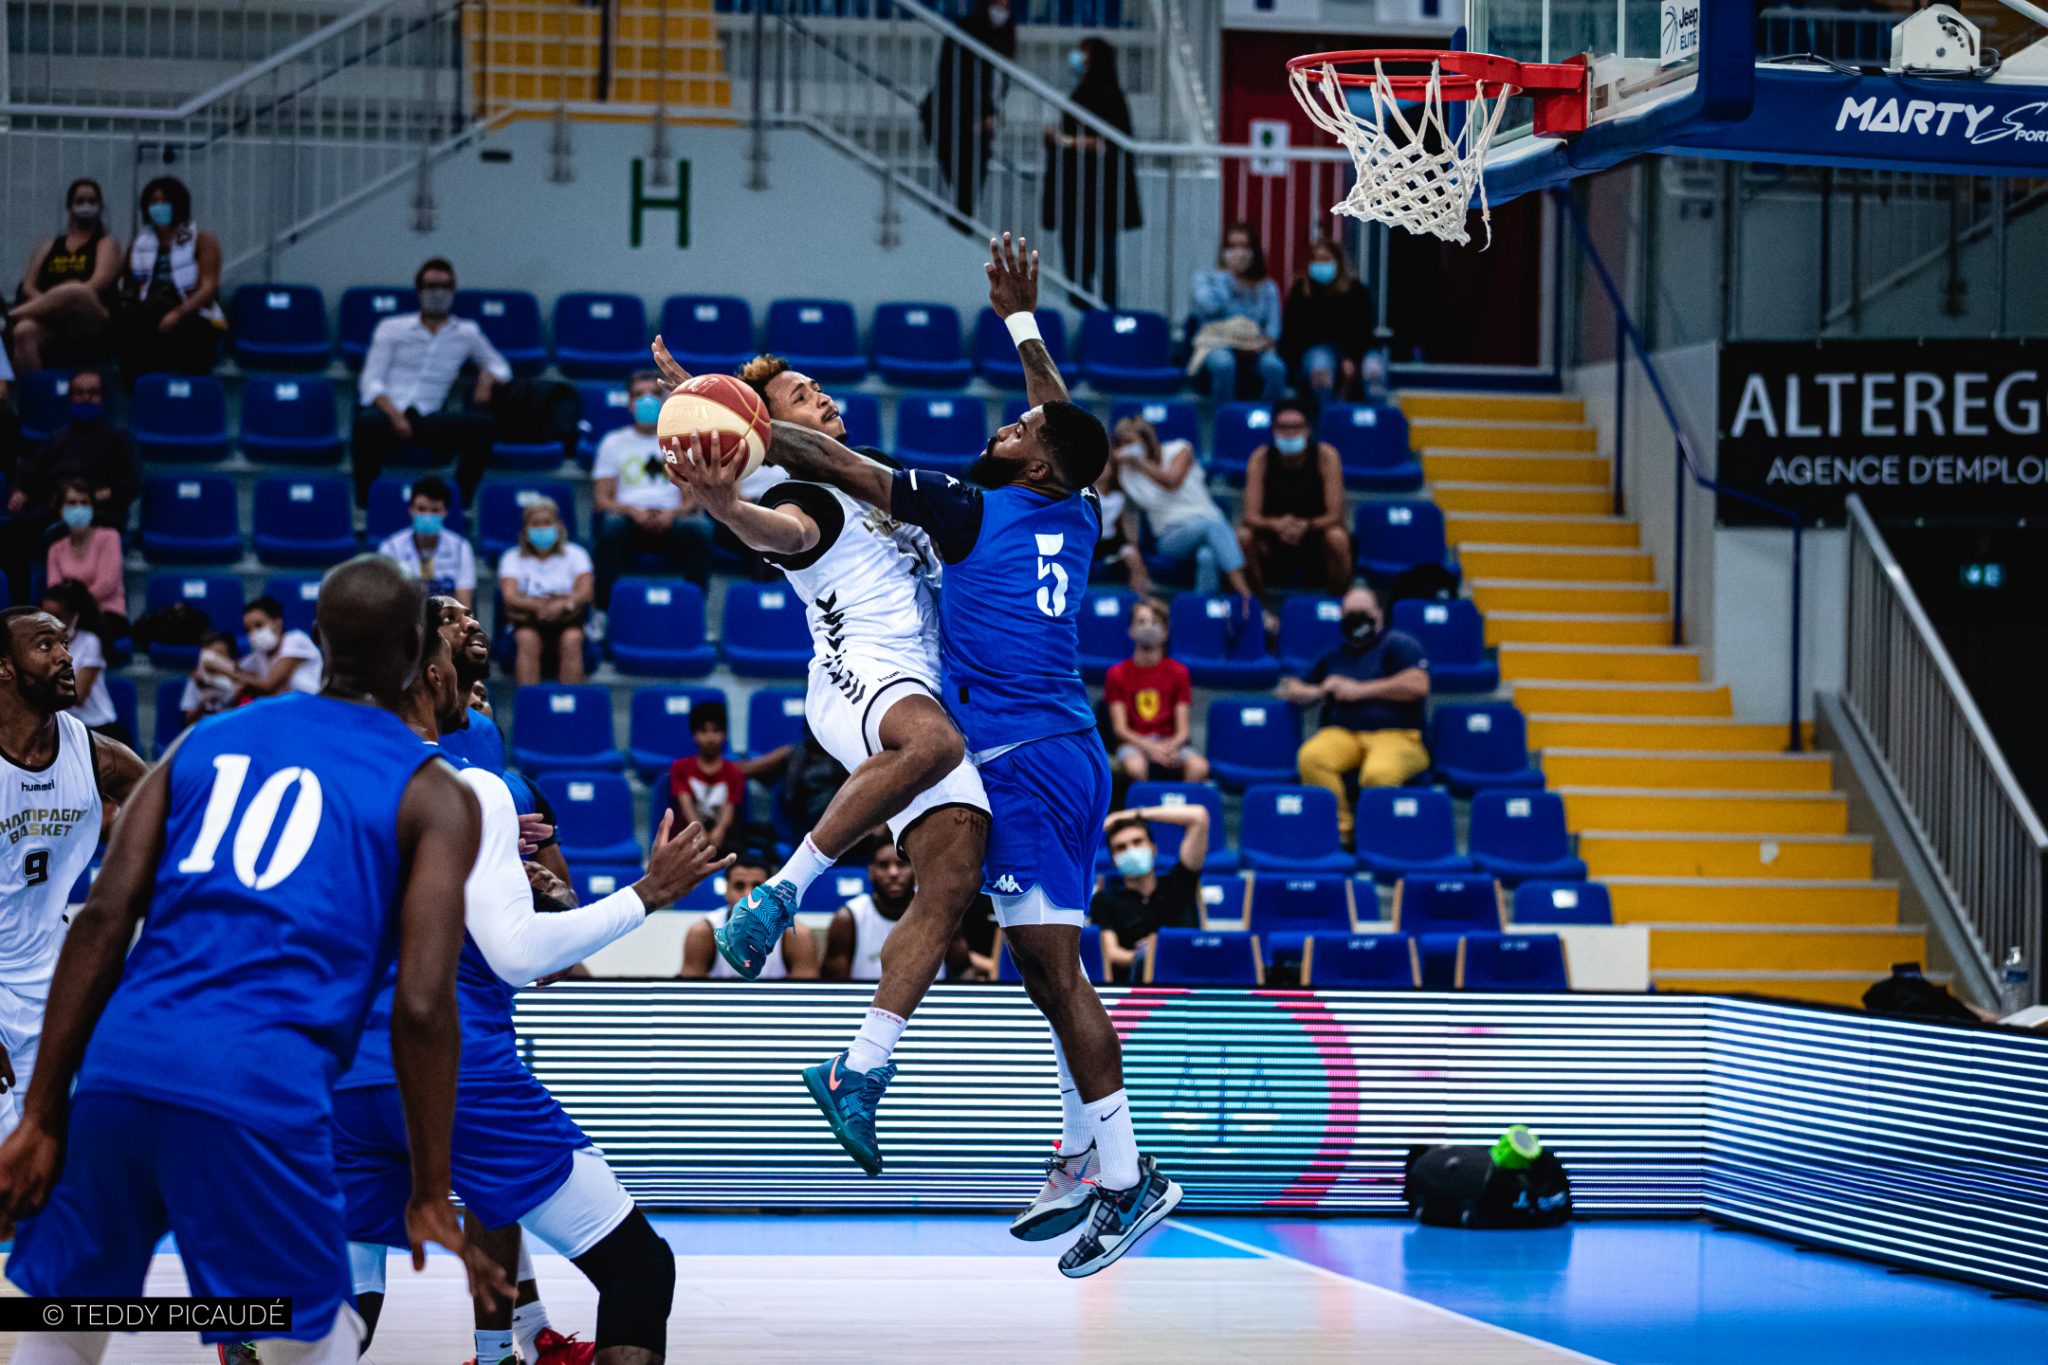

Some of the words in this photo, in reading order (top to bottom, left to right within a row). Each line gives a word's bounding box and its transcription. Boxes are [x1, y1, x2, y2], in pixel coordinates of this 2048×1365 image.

[1679, 6, 1698, 28] Jeep
[1835, 96, 1995, 139] MARTY
[631, 157, 690, 249] H
[1730, 371, 2048, 438] ALTEREG
[1766, 455, 1900, 485] AGENCE
[1034, 532, 1069, 617] 5
[21, 779, 55, 792] hummel
[0, 808, 87, 835] HAMPAGN
[9, 823, 72, 845] BASKET
[178, 753, 323, 891] 10
[24, 850, 49, 887] 9
